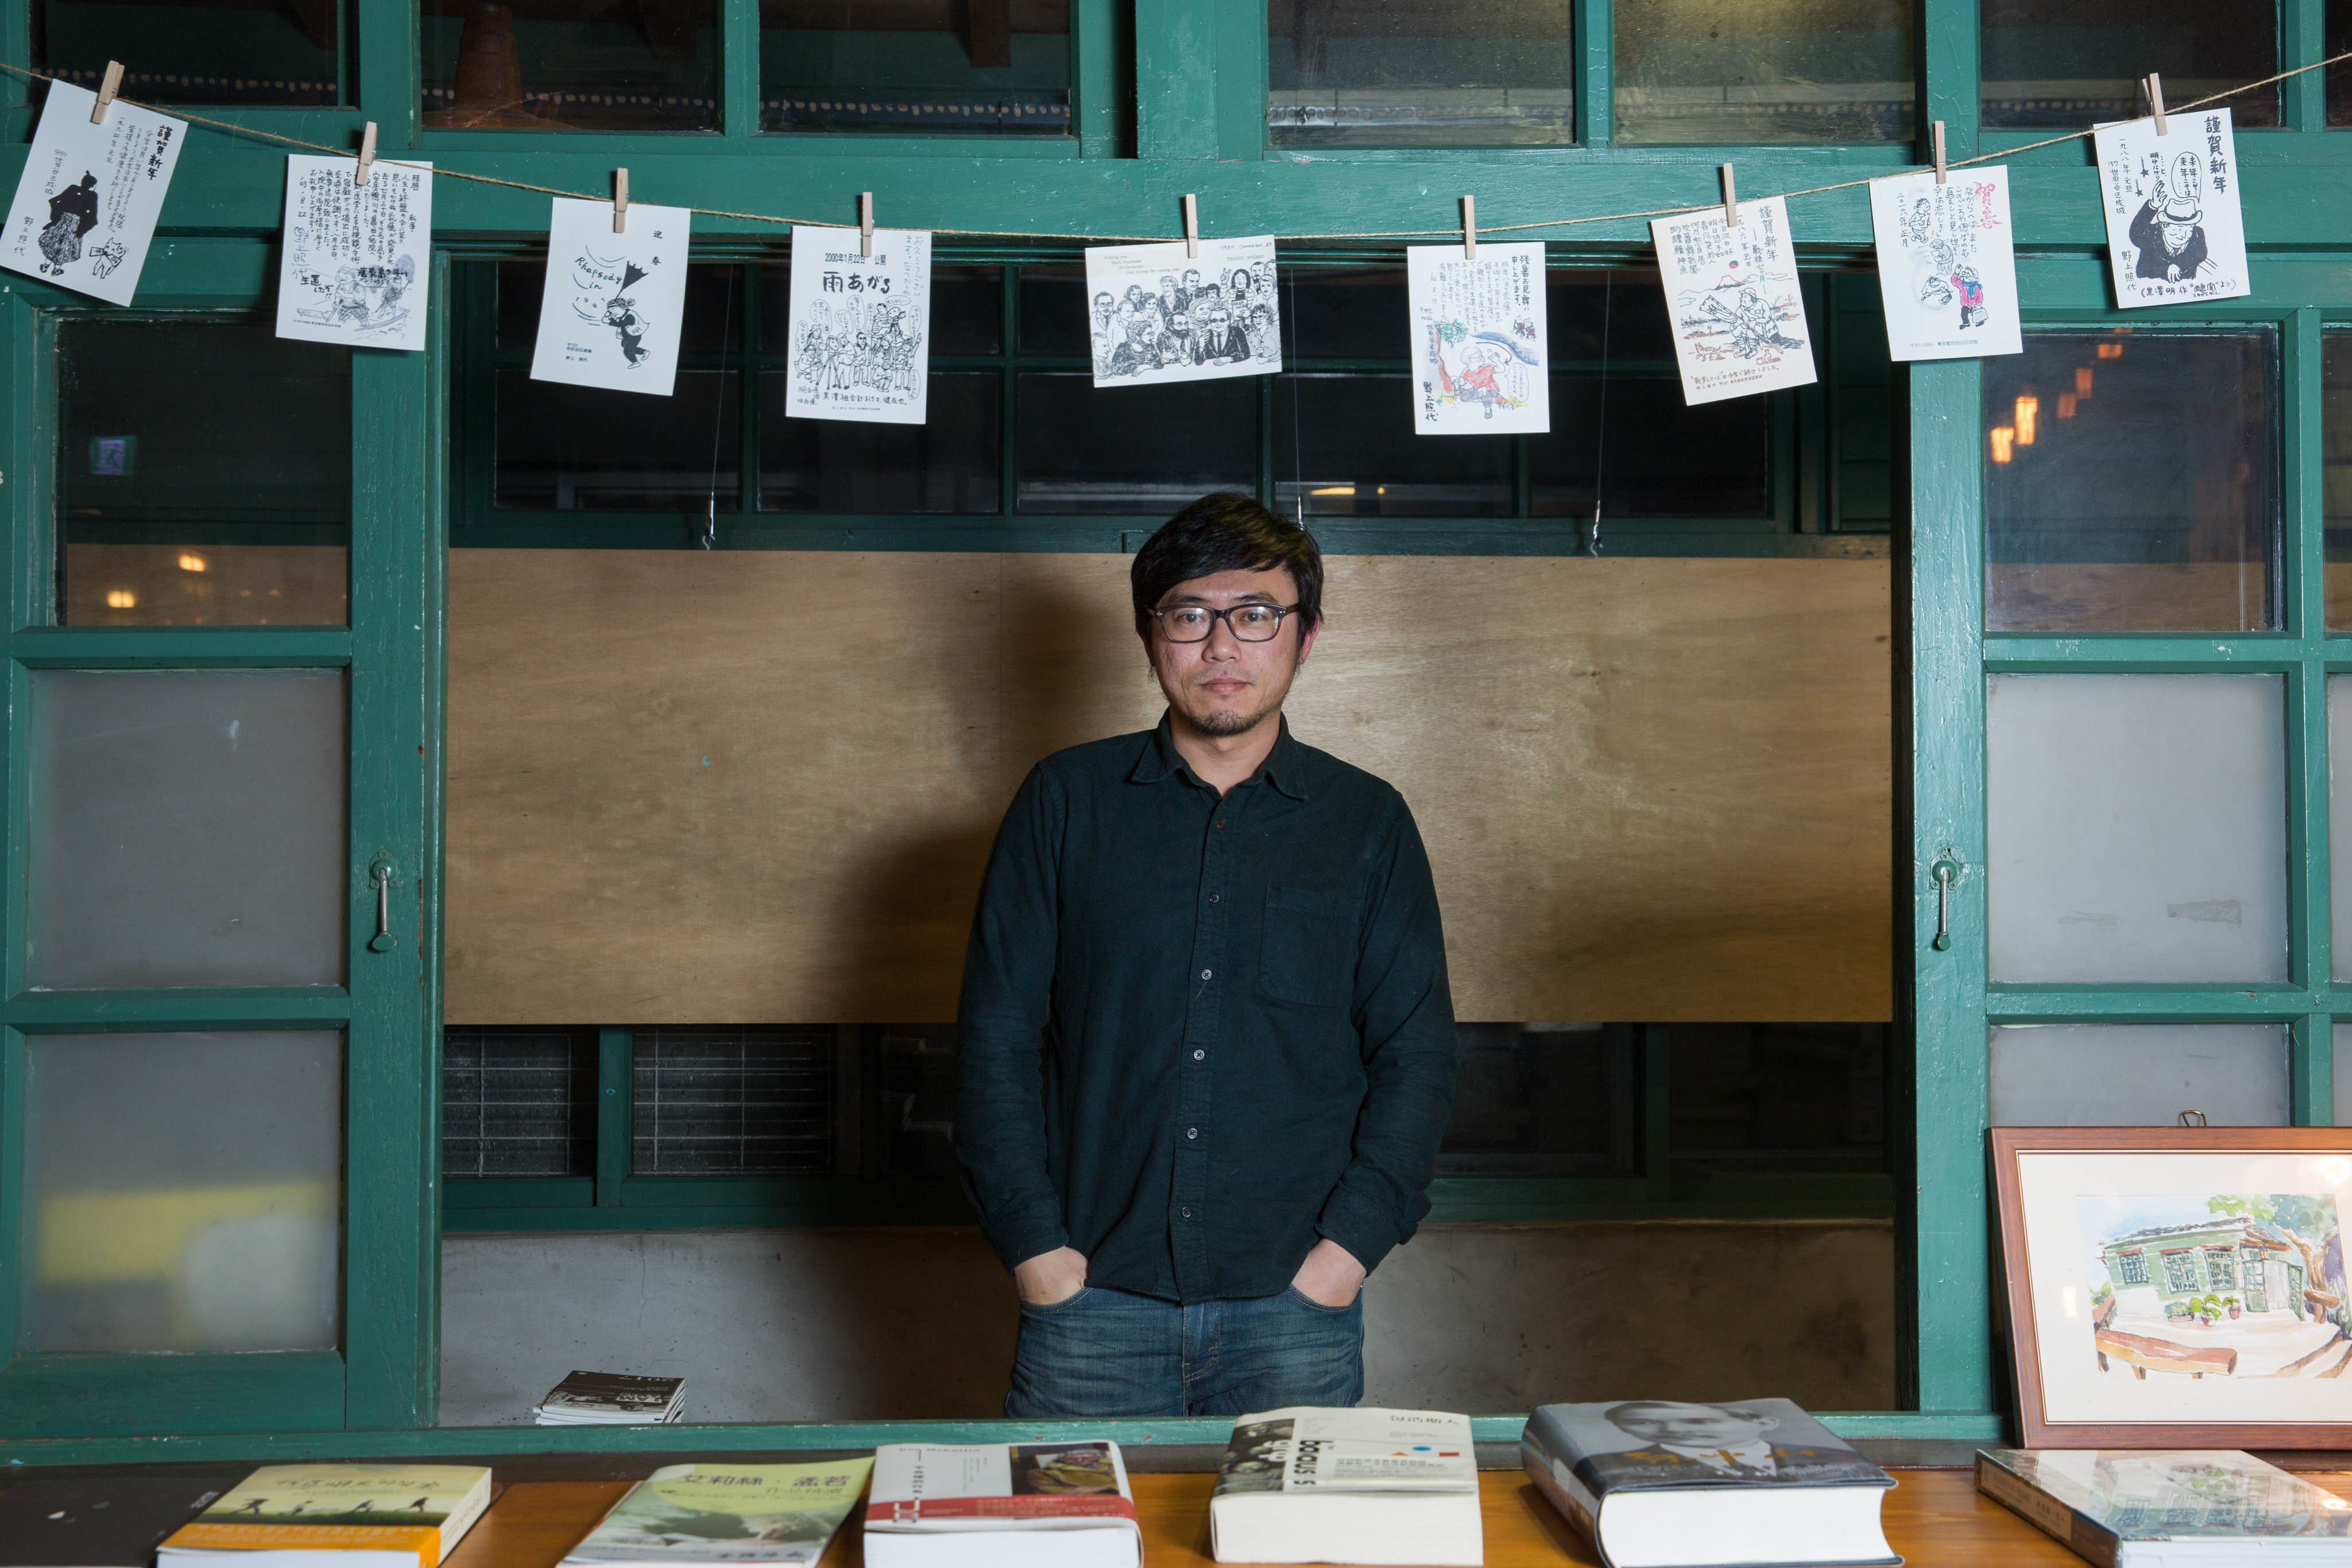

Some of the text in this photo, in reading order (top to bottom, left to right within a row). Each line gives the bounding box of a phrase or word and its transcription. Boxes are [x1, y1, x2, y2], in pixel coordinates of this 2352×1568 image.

[147, 124, 173, 180] 謹賀新年
[2204, 115, 2227, 195] 謹賀新年
[409, 174, 420, 191] 拝啓
[13, 216, 34, 255] 野上照代
[1758, 205, 1778, 261] 謹賀新年
[575, 257, 623, 284] Rhapsody
[874, 254, 887, 266] 公開
[2121, 250, 2137, 292] 野上照代
[823, 271, 890, 293] 雨あがる
[618, 1375, 675, 1383] 2017
